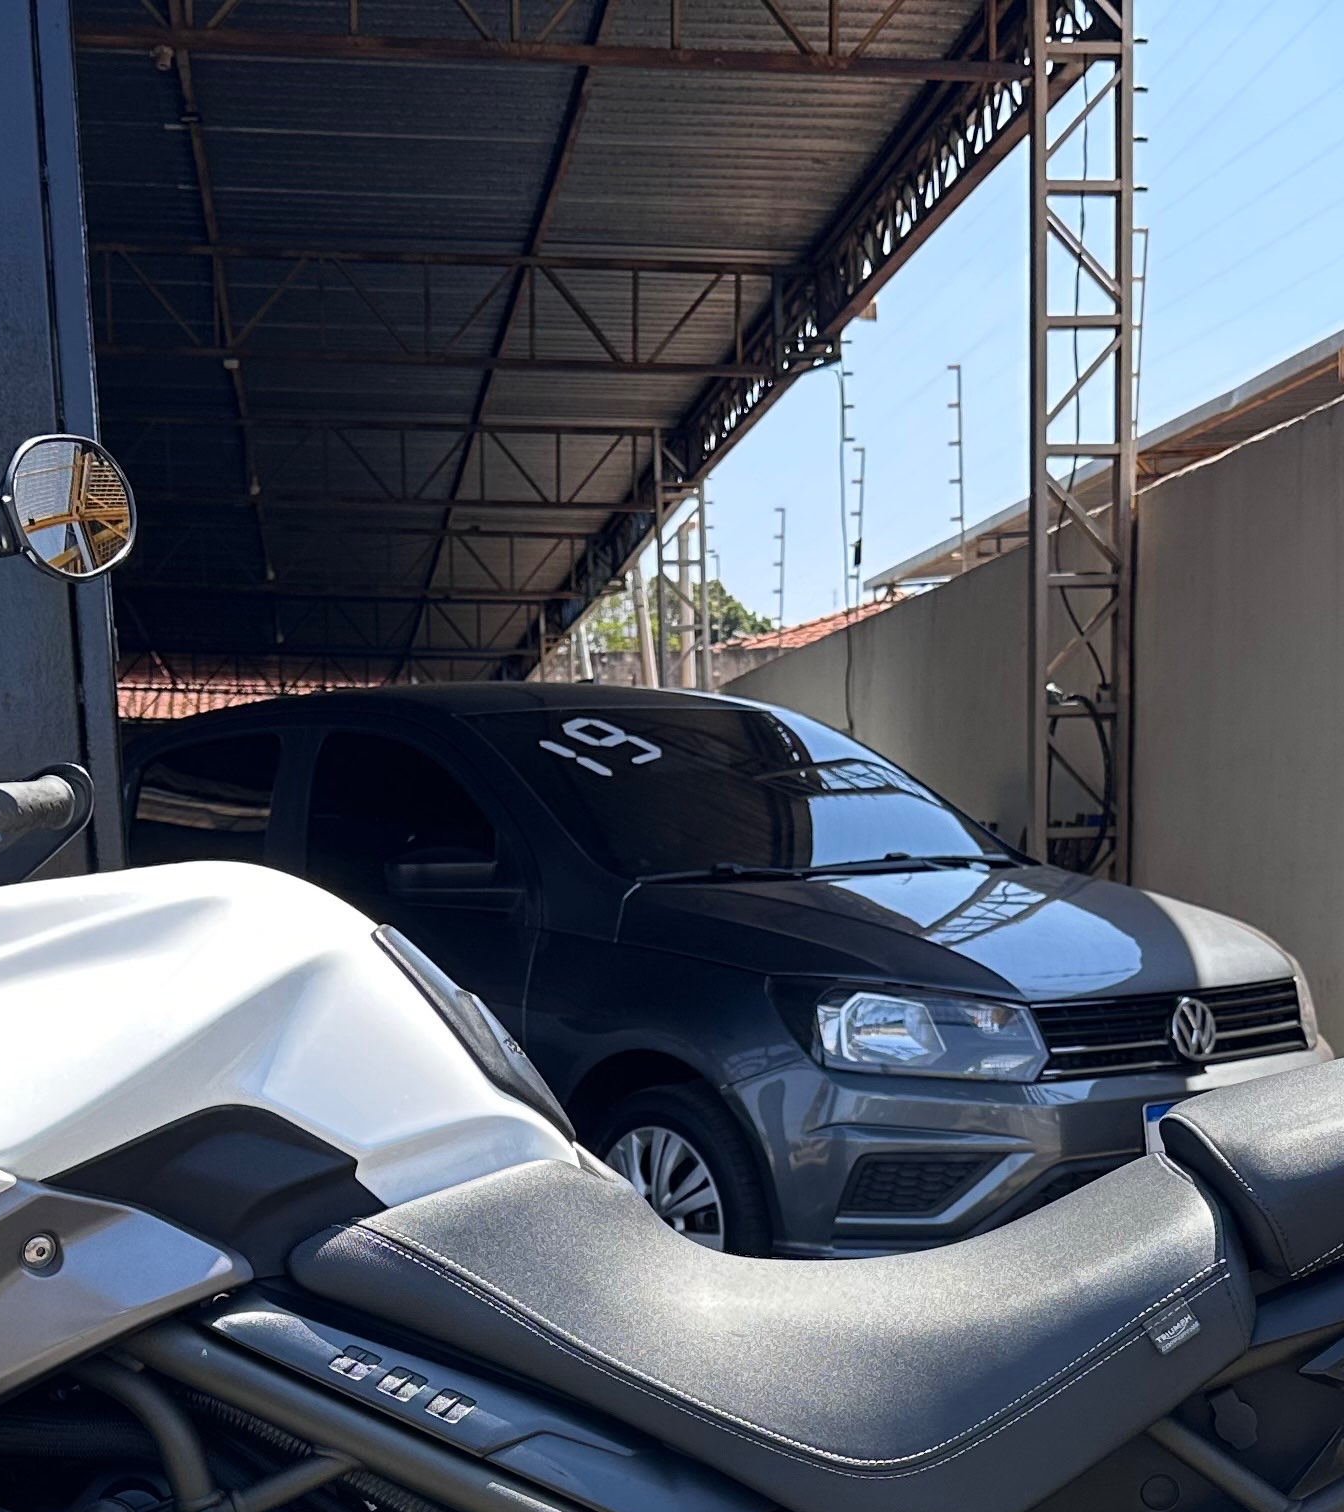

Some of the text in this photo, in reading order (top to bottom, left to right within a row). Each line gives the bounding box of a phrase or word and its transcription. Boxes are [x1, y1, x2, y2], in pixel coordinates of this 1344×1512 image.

[539, 718, 662, 777] 19
[1155, 1313, 1193, 1343] TRIUMPH
[328, 1344, 477, 1424] 800
